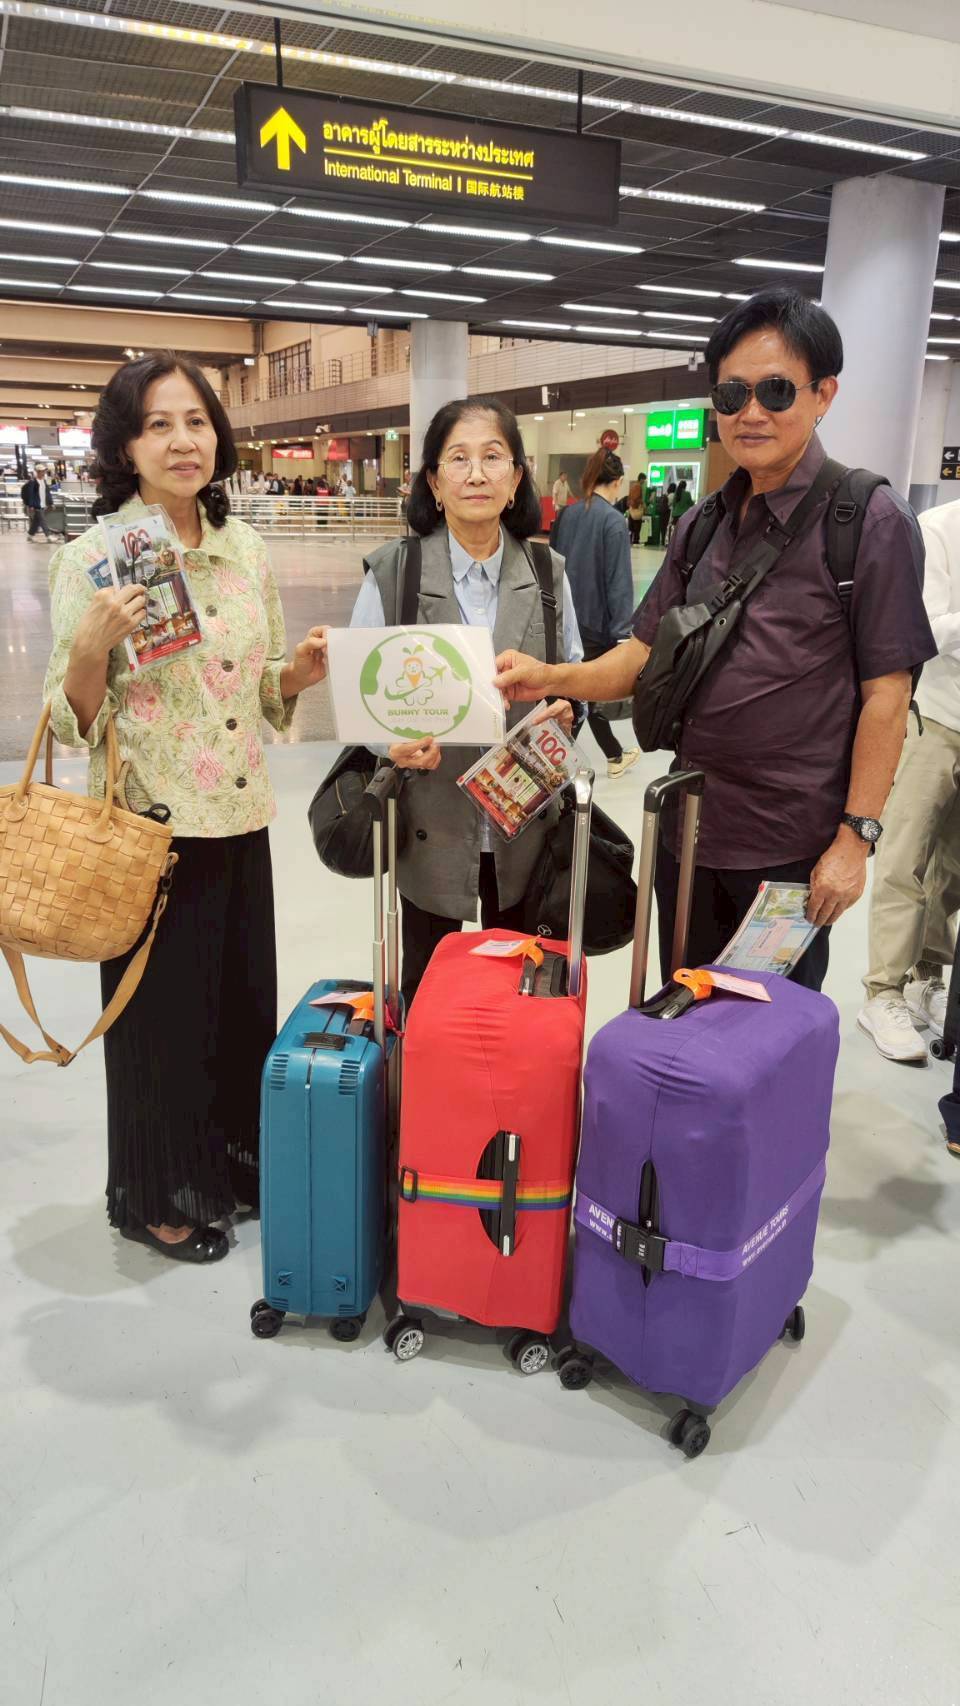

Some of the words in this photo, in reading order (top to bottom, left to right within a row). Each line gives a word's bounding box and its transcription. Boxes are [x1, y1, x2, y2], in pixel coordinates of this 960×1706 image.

[322, 117, 534, 168] อาคารผู้โดยสารระหว่างประเทศ
[324, 157, 400, 185] International
[402, 168, 453, 192] Terminal
[466, 179, 525, 201] 国际航站楼
[387, 708, 419, 717] BUNNY
[423, 708, 449, 717] TOUR
[742, 1224, 769, 1256] AVENUE
